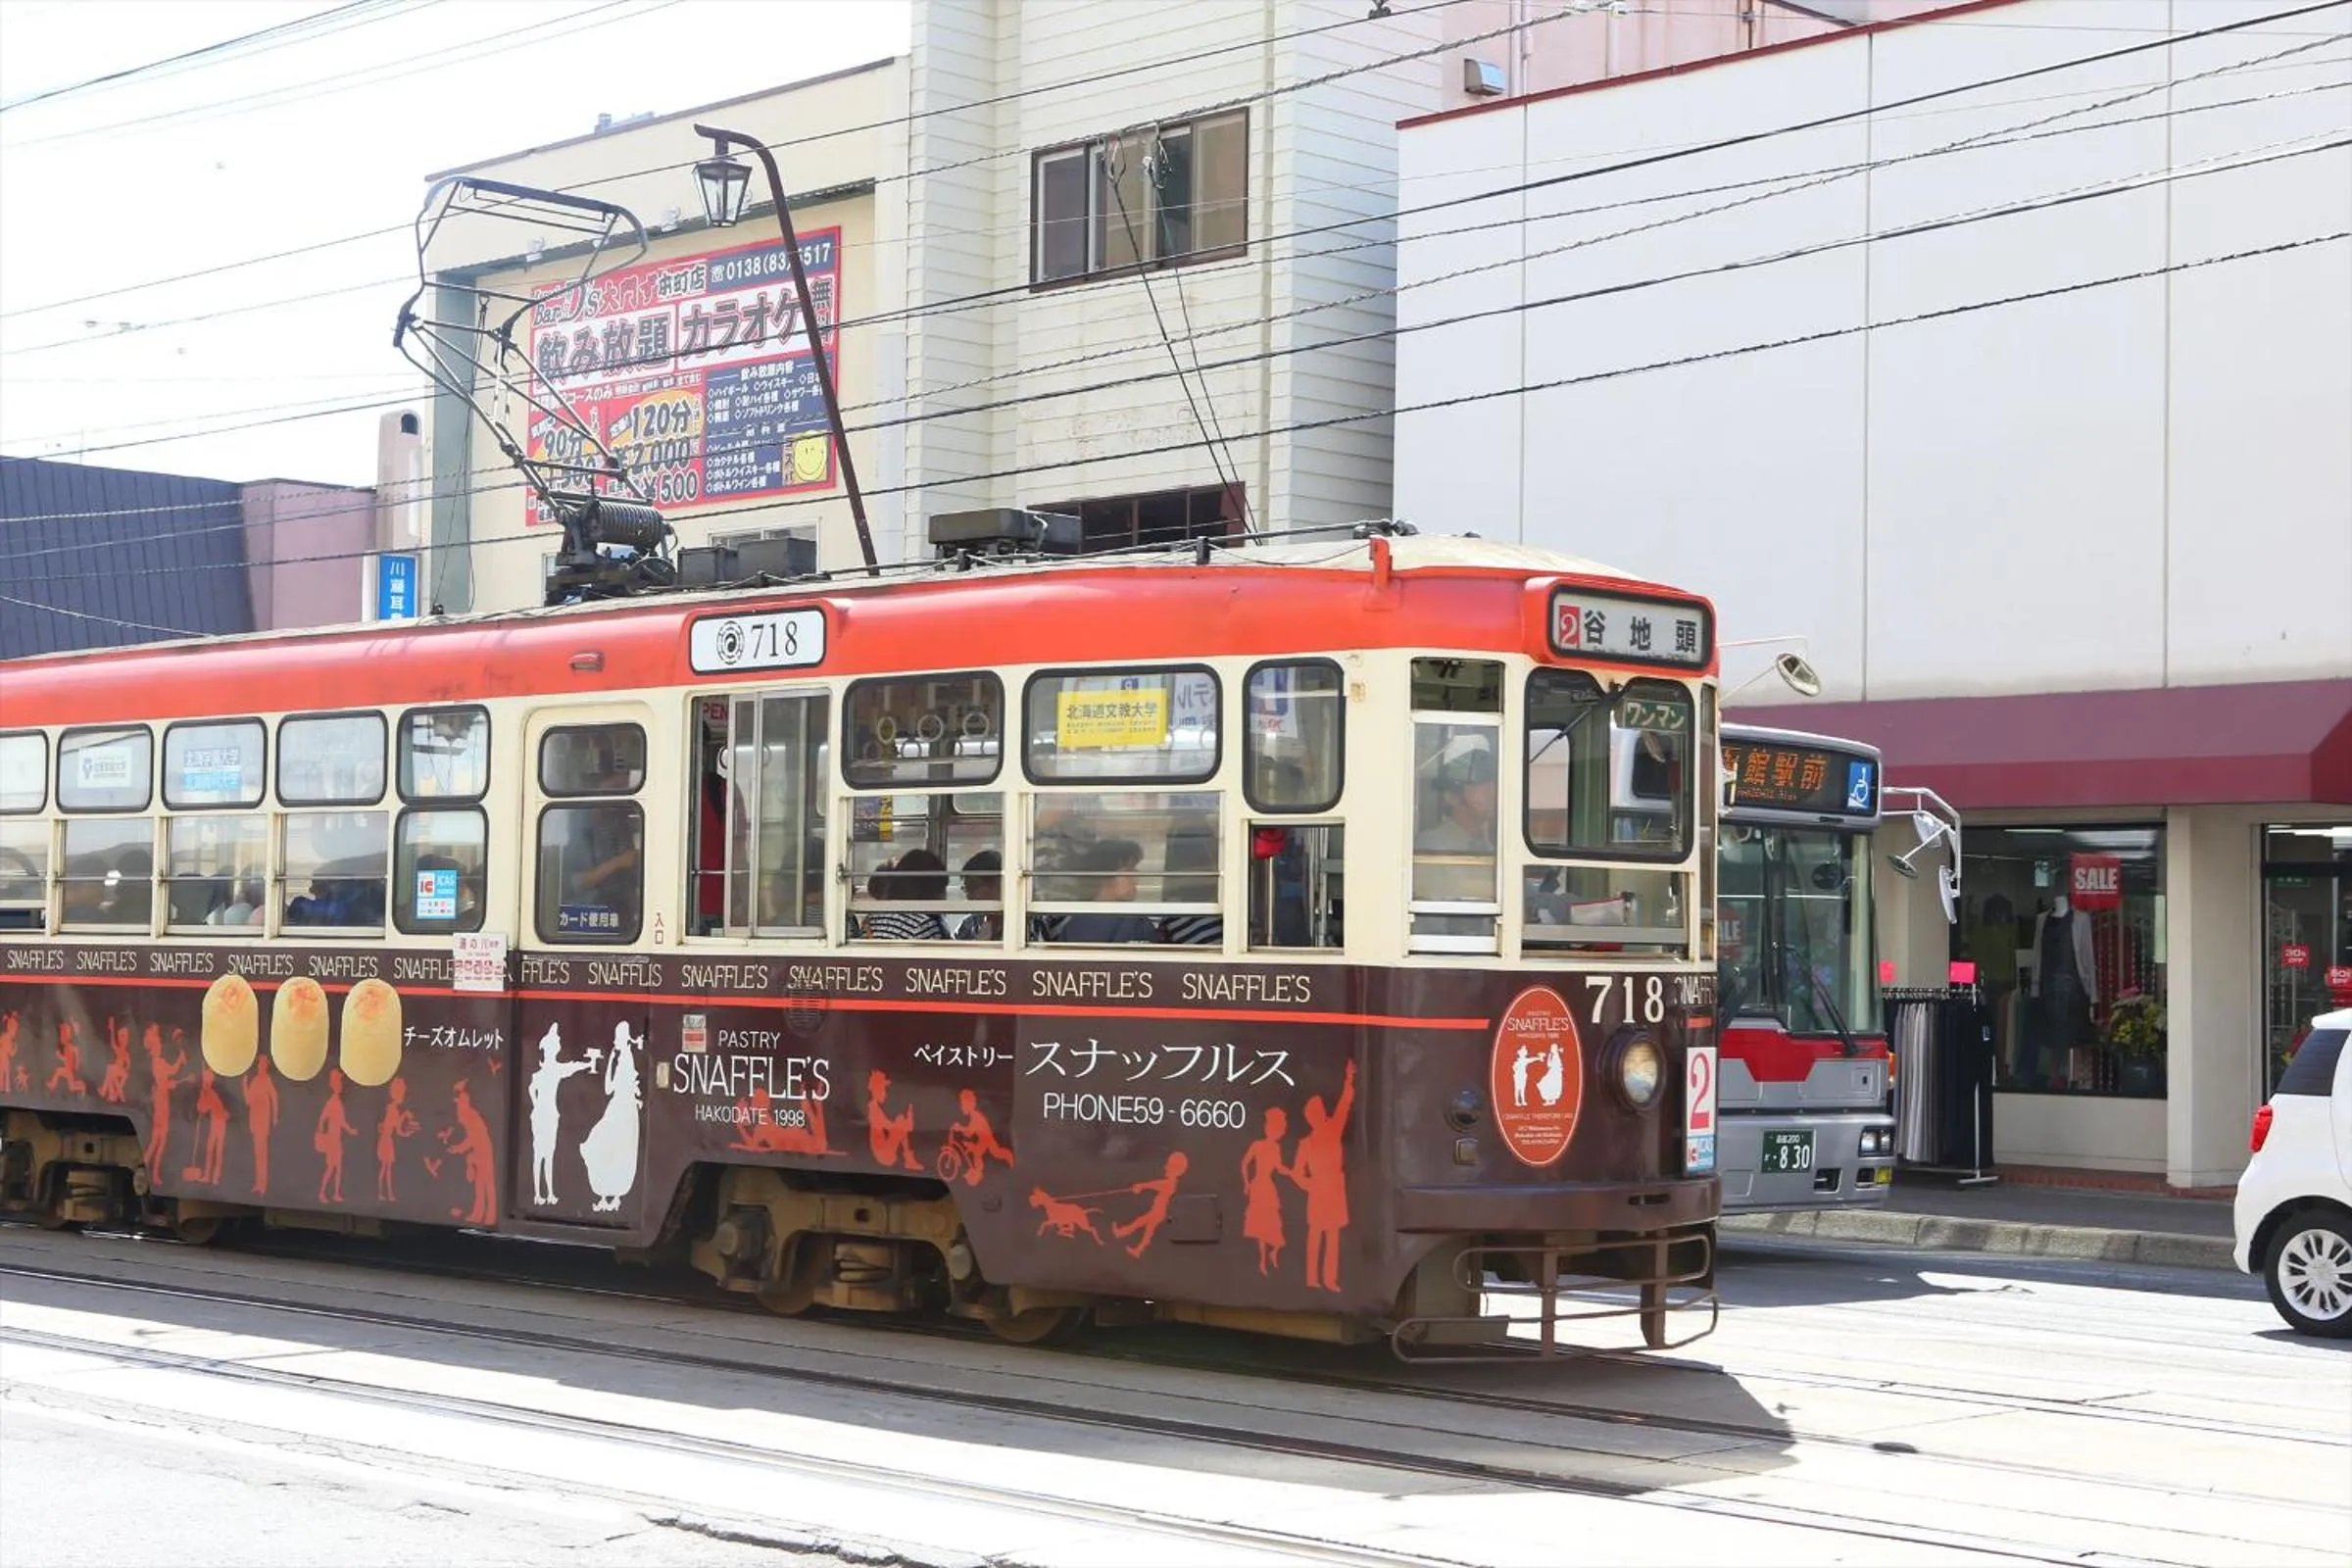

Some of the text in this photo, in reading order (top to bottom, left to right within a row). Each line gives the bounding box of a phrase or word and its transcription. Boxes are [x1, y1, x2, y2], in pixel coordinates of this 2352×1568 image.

[682, 288, 803, 360] カラオケ
[538, 313, 670, 383] 飲み放題
[632, 399, 692, 439] 120分
[751, 620, 798, 659] 718
[1560, 610, 1697, 653] 2 谷地頭
[1066, 702, 1157, 719] 北海道文教大学
[1627, 702, 1685, 729] ワンマン
[2075, 867, 2118, 890] SALE
[655, 912, 664, 945] 入口
[681, 964, 768, 989] SNAFFLE'S
[788, 965, 883, 992] SNAFFLE'S
[906, 967, 1006, 996] SNAFFLE'S
[1032, 970, 1153, 999] SNAFFLE'S
[1182, 972, 1311, 1003] SNAFFLE'S
[1585, 976, 1665, 1024] 718
[404, 1026, 505, 1051] チーズオムレット
[717, 1030, 781, 1050] PASTRY
[913, 1043, 1014, 1067] ペイストリー
[673, 1053, 831, 1102] SNAFFLE'S
[1026, 1039, 1296, 1087] スナッフルス
[1690, 1053, 1710, 1130] 2
[696, 1104, 806, 1128] HAKODATE 1998
